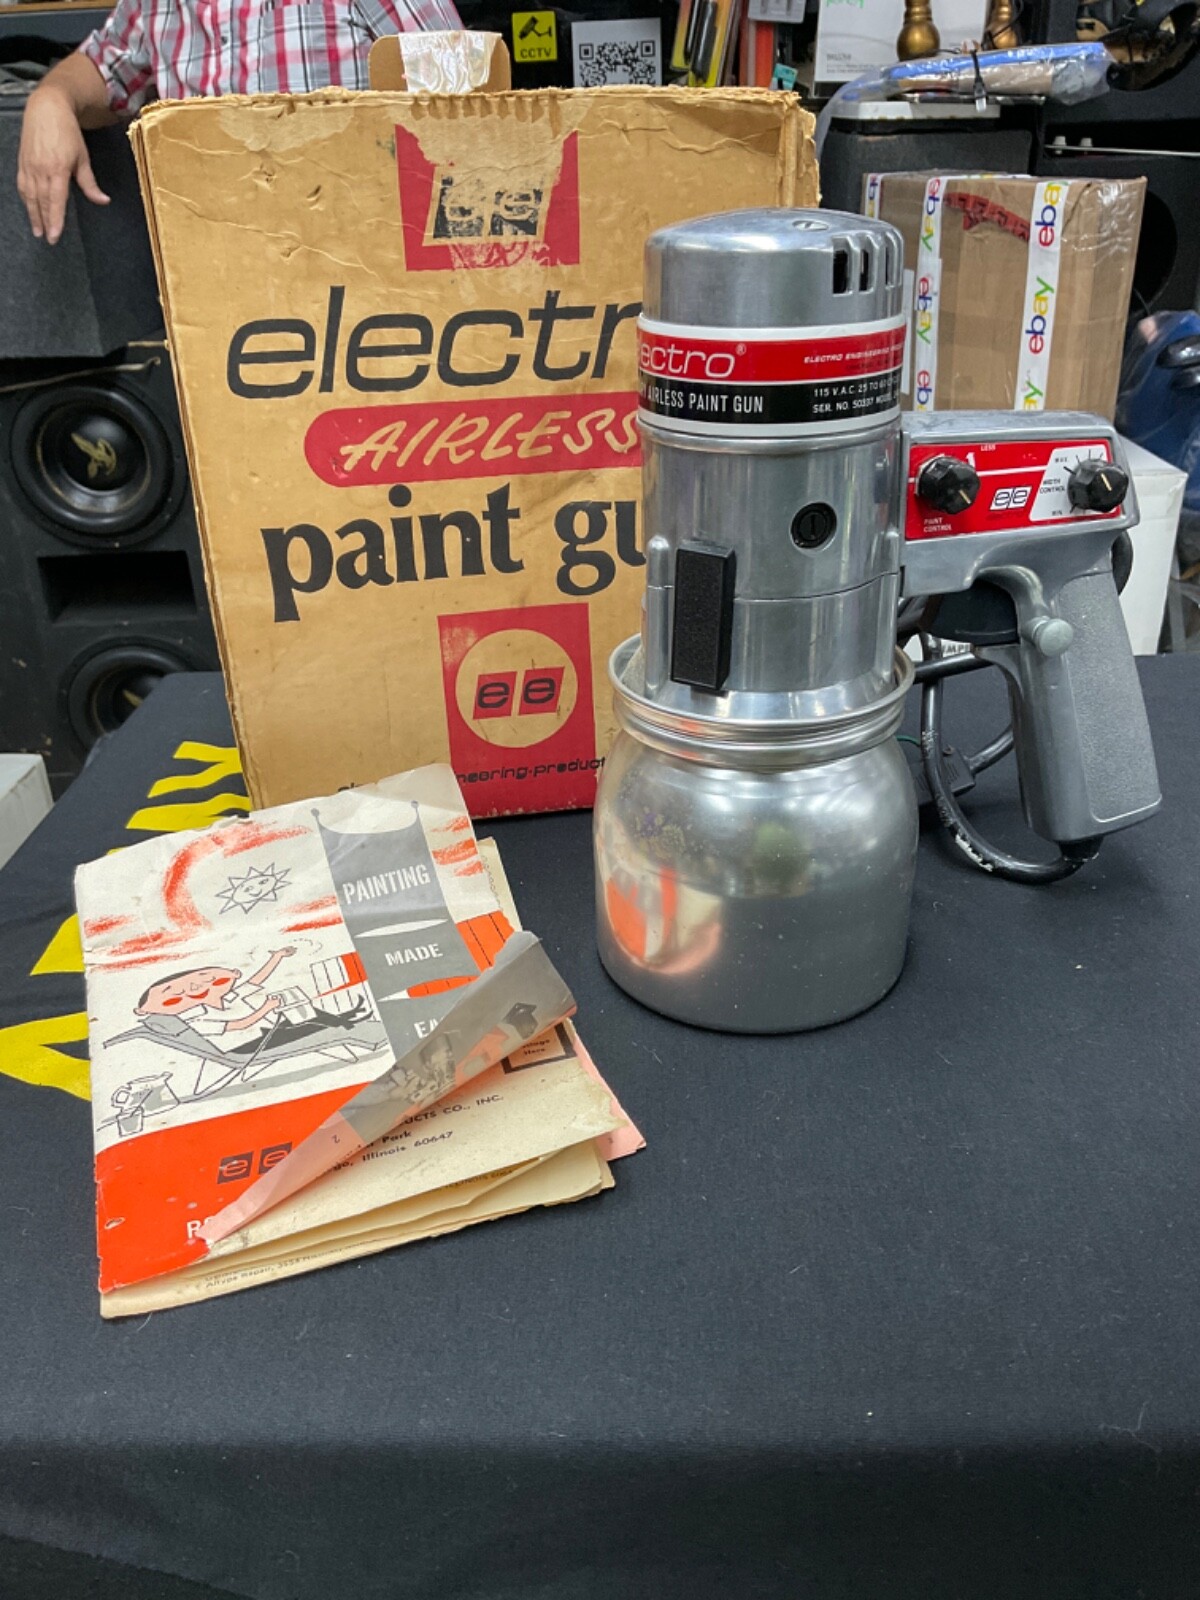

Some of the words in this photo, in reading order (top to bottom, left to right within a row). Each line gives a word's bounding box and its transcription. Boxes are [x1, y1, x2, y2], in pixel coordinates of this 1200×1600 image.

[520, 47, 551, 58] CCTV
[921, 179, 941, 252] ebay
[916, 277, 932, 344] ebay
[1025, 276, 1054, 354] ebay
[647, 386, 684, 409] AIRLESS
[689, 393, 729, 412] PAINT
[733, 396, 763, 413] GUN
[340, 408, 640, 473] AIRLESS
[260, 483, 525, 623] paint
[342, 864, 431, 905] PAINTING
[384, 943, 444, 967] MADE
[476, 1094, 504, 1106] INC.
[362, 1146, 407, 1163] Illinois
[414, 1131, 453, 1148] 60647
[382, 1130, 412, 1144] Park
